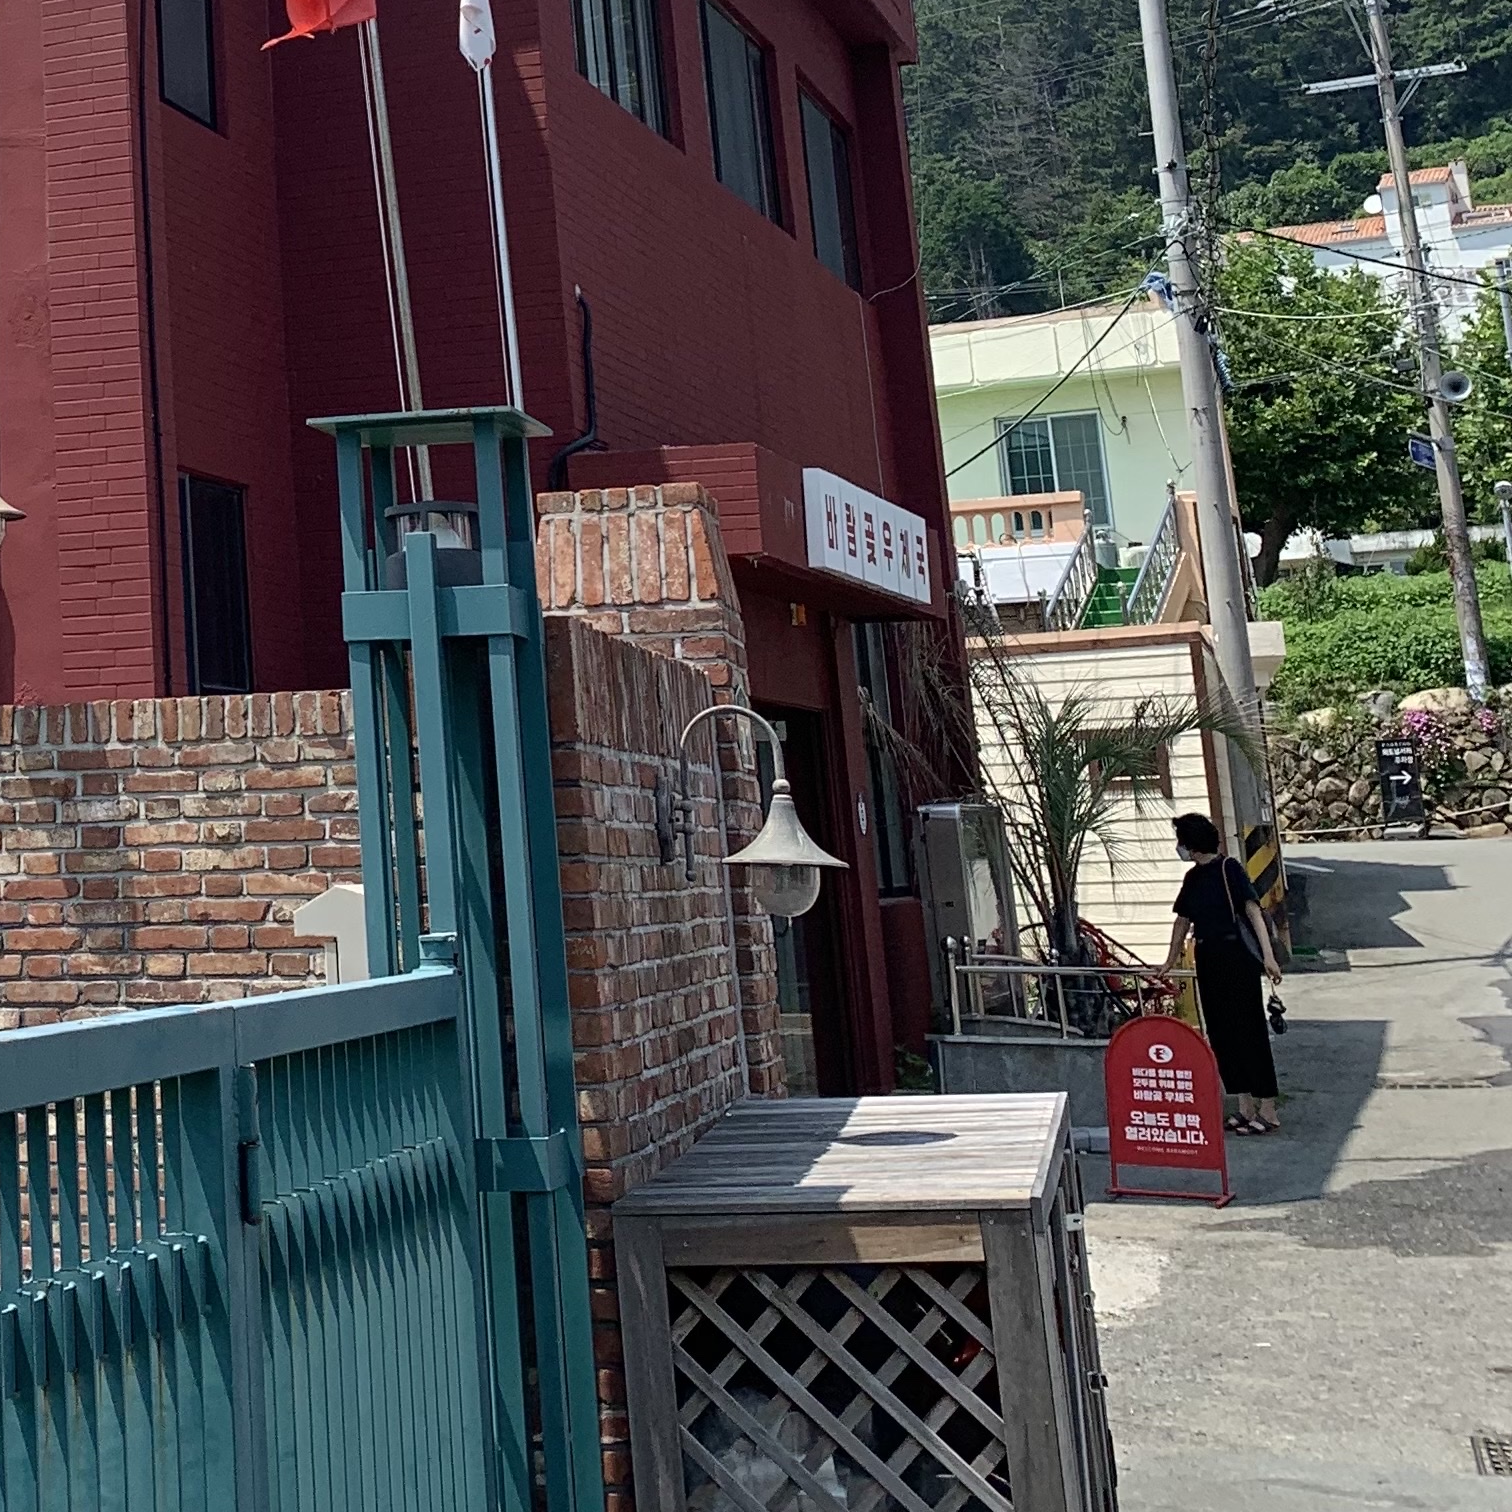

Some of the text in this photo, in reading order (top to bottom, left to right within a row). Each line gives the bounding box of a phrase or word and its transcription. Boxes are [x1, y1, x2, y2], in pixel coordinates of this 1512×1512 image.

[825, 494, 926, 584] 바람곶우체국
[1130, 1110, 1170, 1127] 오늘도
[1124, 1126, 1209, 1146] 열려있습니다.
